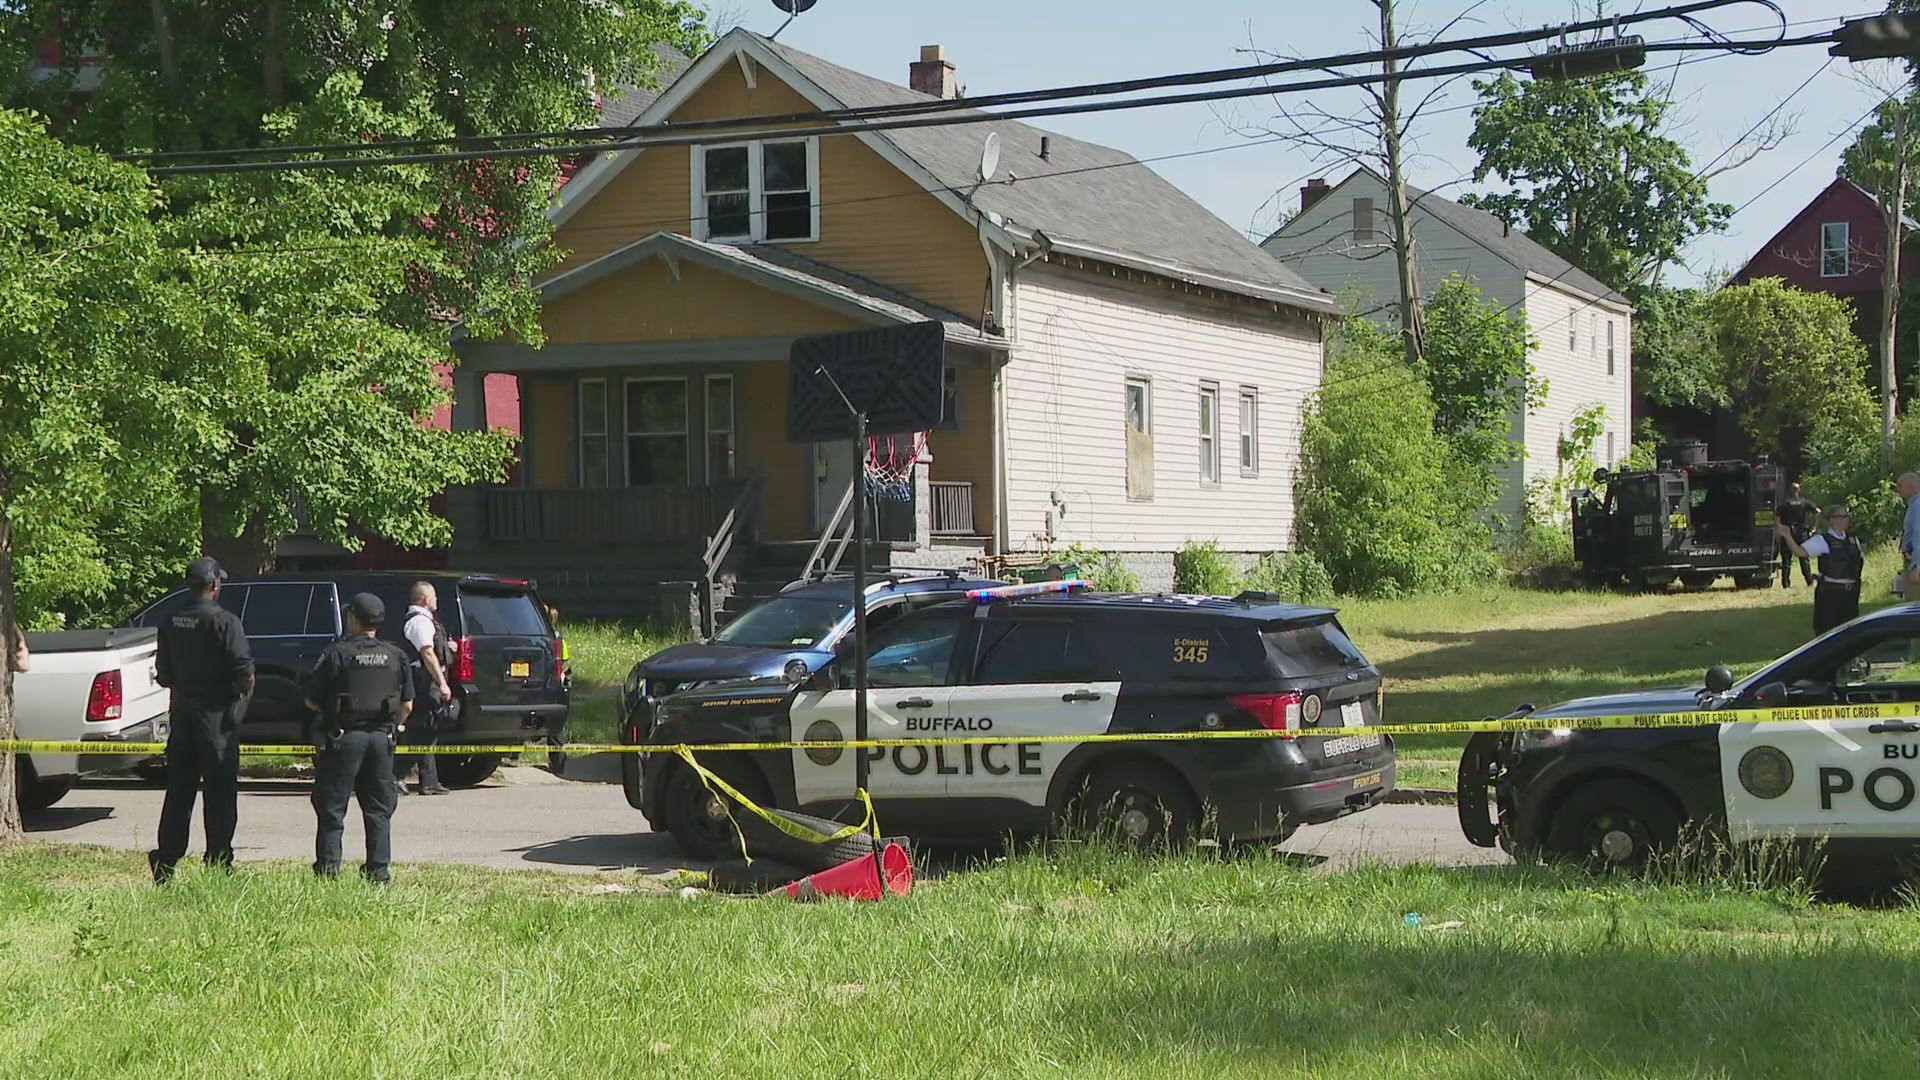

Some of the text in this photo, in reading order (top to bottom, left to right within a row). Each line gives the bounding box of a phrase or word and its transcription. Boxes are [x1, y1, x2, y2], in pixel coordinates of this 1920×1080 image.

[1173, 646, 1208, 663] 345
[1634, 711, 1738, 726] POLICE LINE DO NOT CROSS
[1772, 709, 1799, 720] POLICE
[1801, 709, 1819, 720] LINE
[1822, 708, 1833, 719] DO
[1835, 707, 1850, 718] NOT
[1852, 706, 1880, 718] CROSS
[906, 717, 993, 731] BUFFALO
[1501, 721, 1527, 730] POLICE
[1529, 720, 1545, 728] LINE
[1548, 719, 1558, 728] DO
[1560, 719, 1575, 727] NOT
[1323, 736, 1359, 758] BUFFALO
[1884, 744, 1919, 759] BU
[867, 738, 1042, 776] POLICE
[1819, 767, 1915, 811] PO
